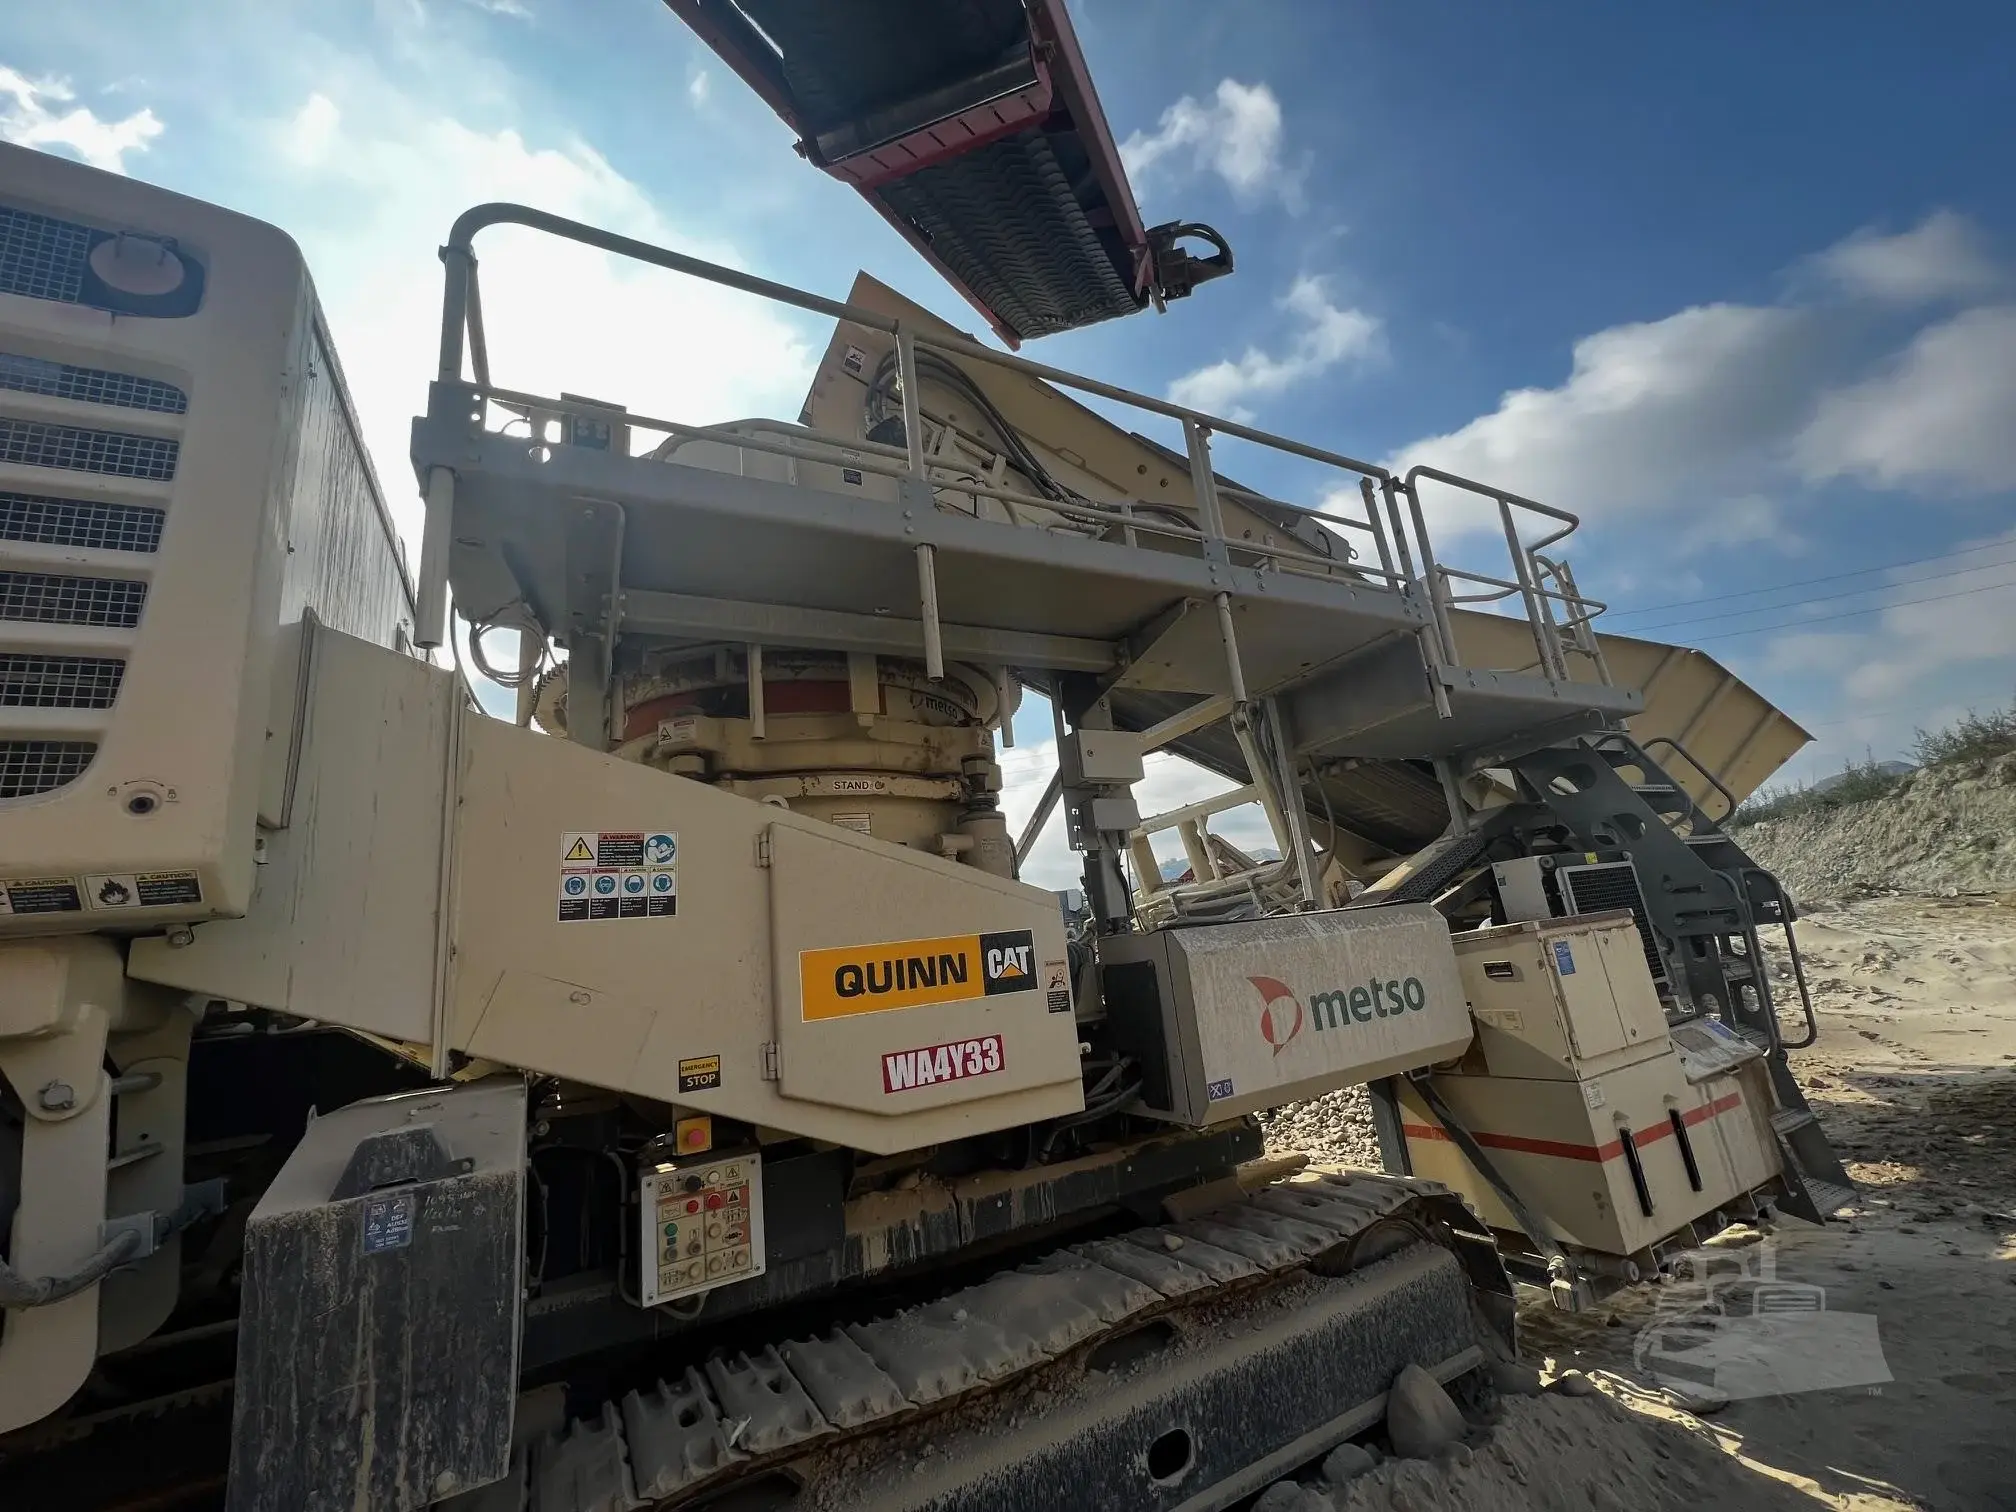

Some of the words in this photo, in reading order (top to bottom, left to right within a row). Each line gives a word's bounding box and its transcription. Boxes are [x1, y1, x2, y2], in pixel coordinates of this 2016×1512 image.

[834, 781, 869, 790] STAND
[150, 872, 192, 880] CAUTION
[24, 879, 68, 887] CAUTION
[835, 952, 967, 998] QUINN
[987, 945, 1031, 980] CAT
[1310, 975, 1425, 1031] metso
[681, 1061, 717, 1072] EMERGENCY
[886, 1038, 1001, 1091] WA4Y33
[686, 1073, 716, 1087] STOP
